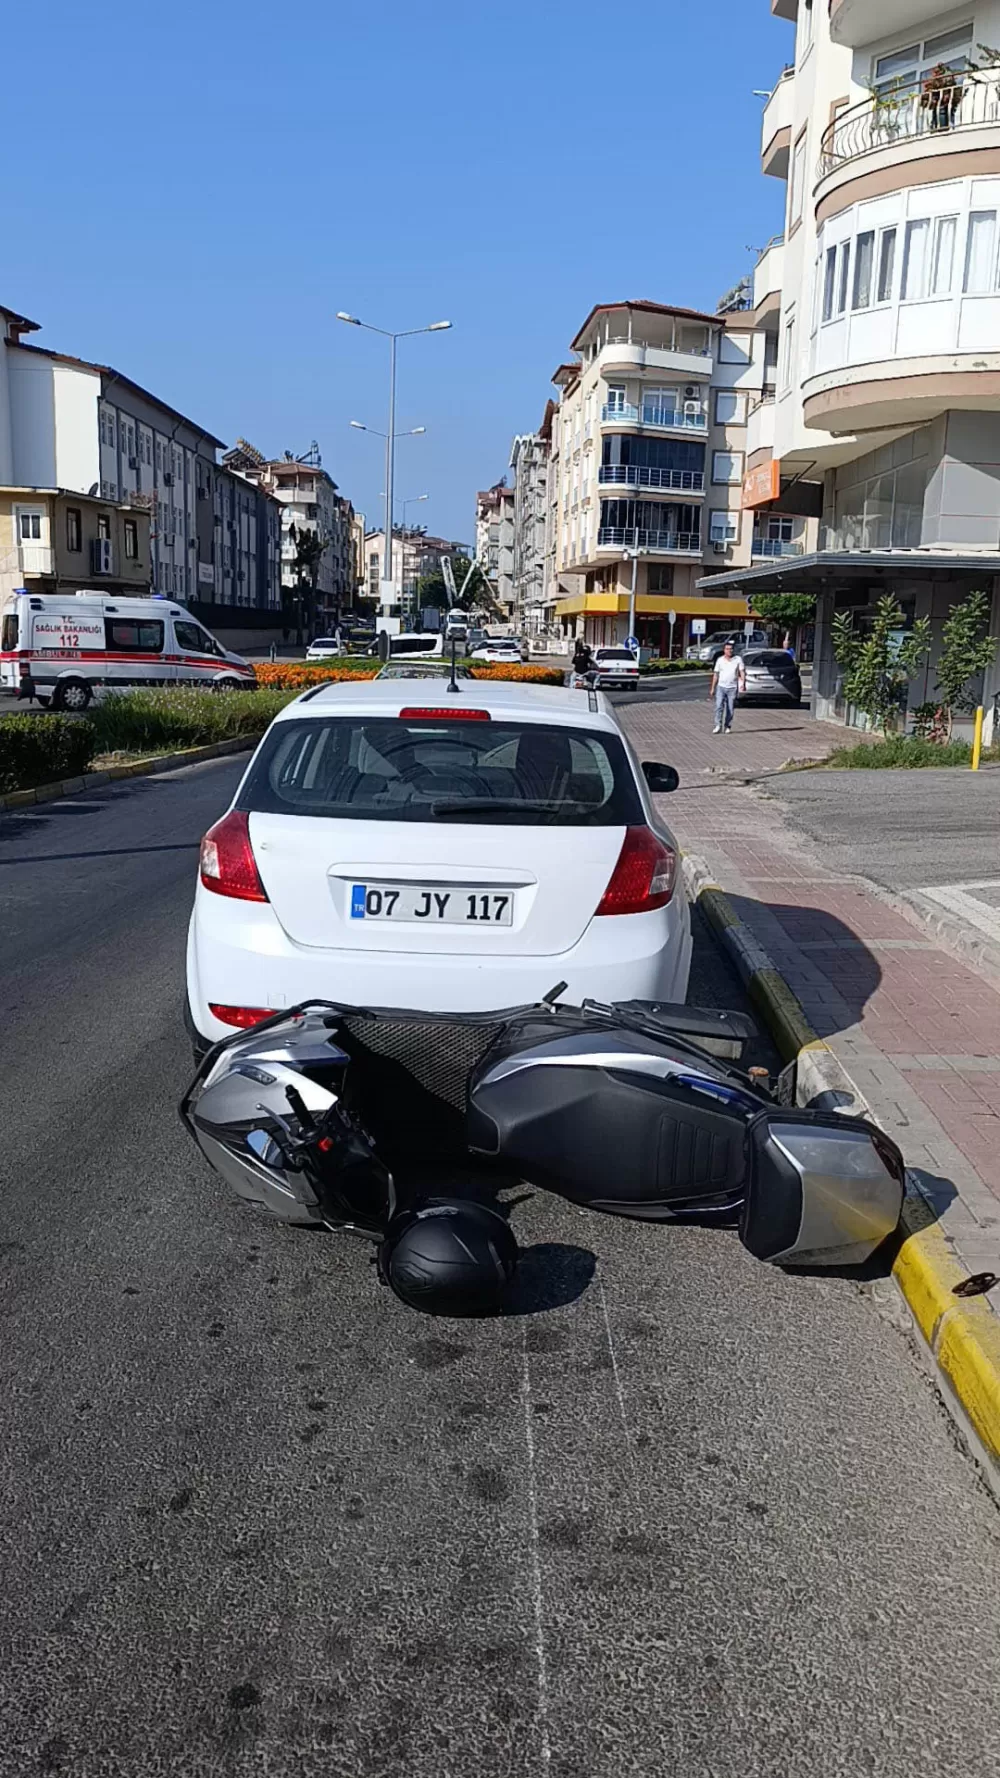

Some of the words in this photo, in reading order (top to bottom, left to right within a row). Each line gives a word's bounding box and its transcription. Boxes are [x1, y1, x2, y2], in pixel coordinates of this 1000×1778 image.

[35, 624, 62, 633] SAĞLIK
[63, 625, 102, 634] BAKANLIĞI
[60, 634, 79, 647] 112
[354, 904, 364, 912] TR
[366, 890, 400, 916] 07
[414, 892, 451, 918] JY
[466, 895, 509, 921] 117
